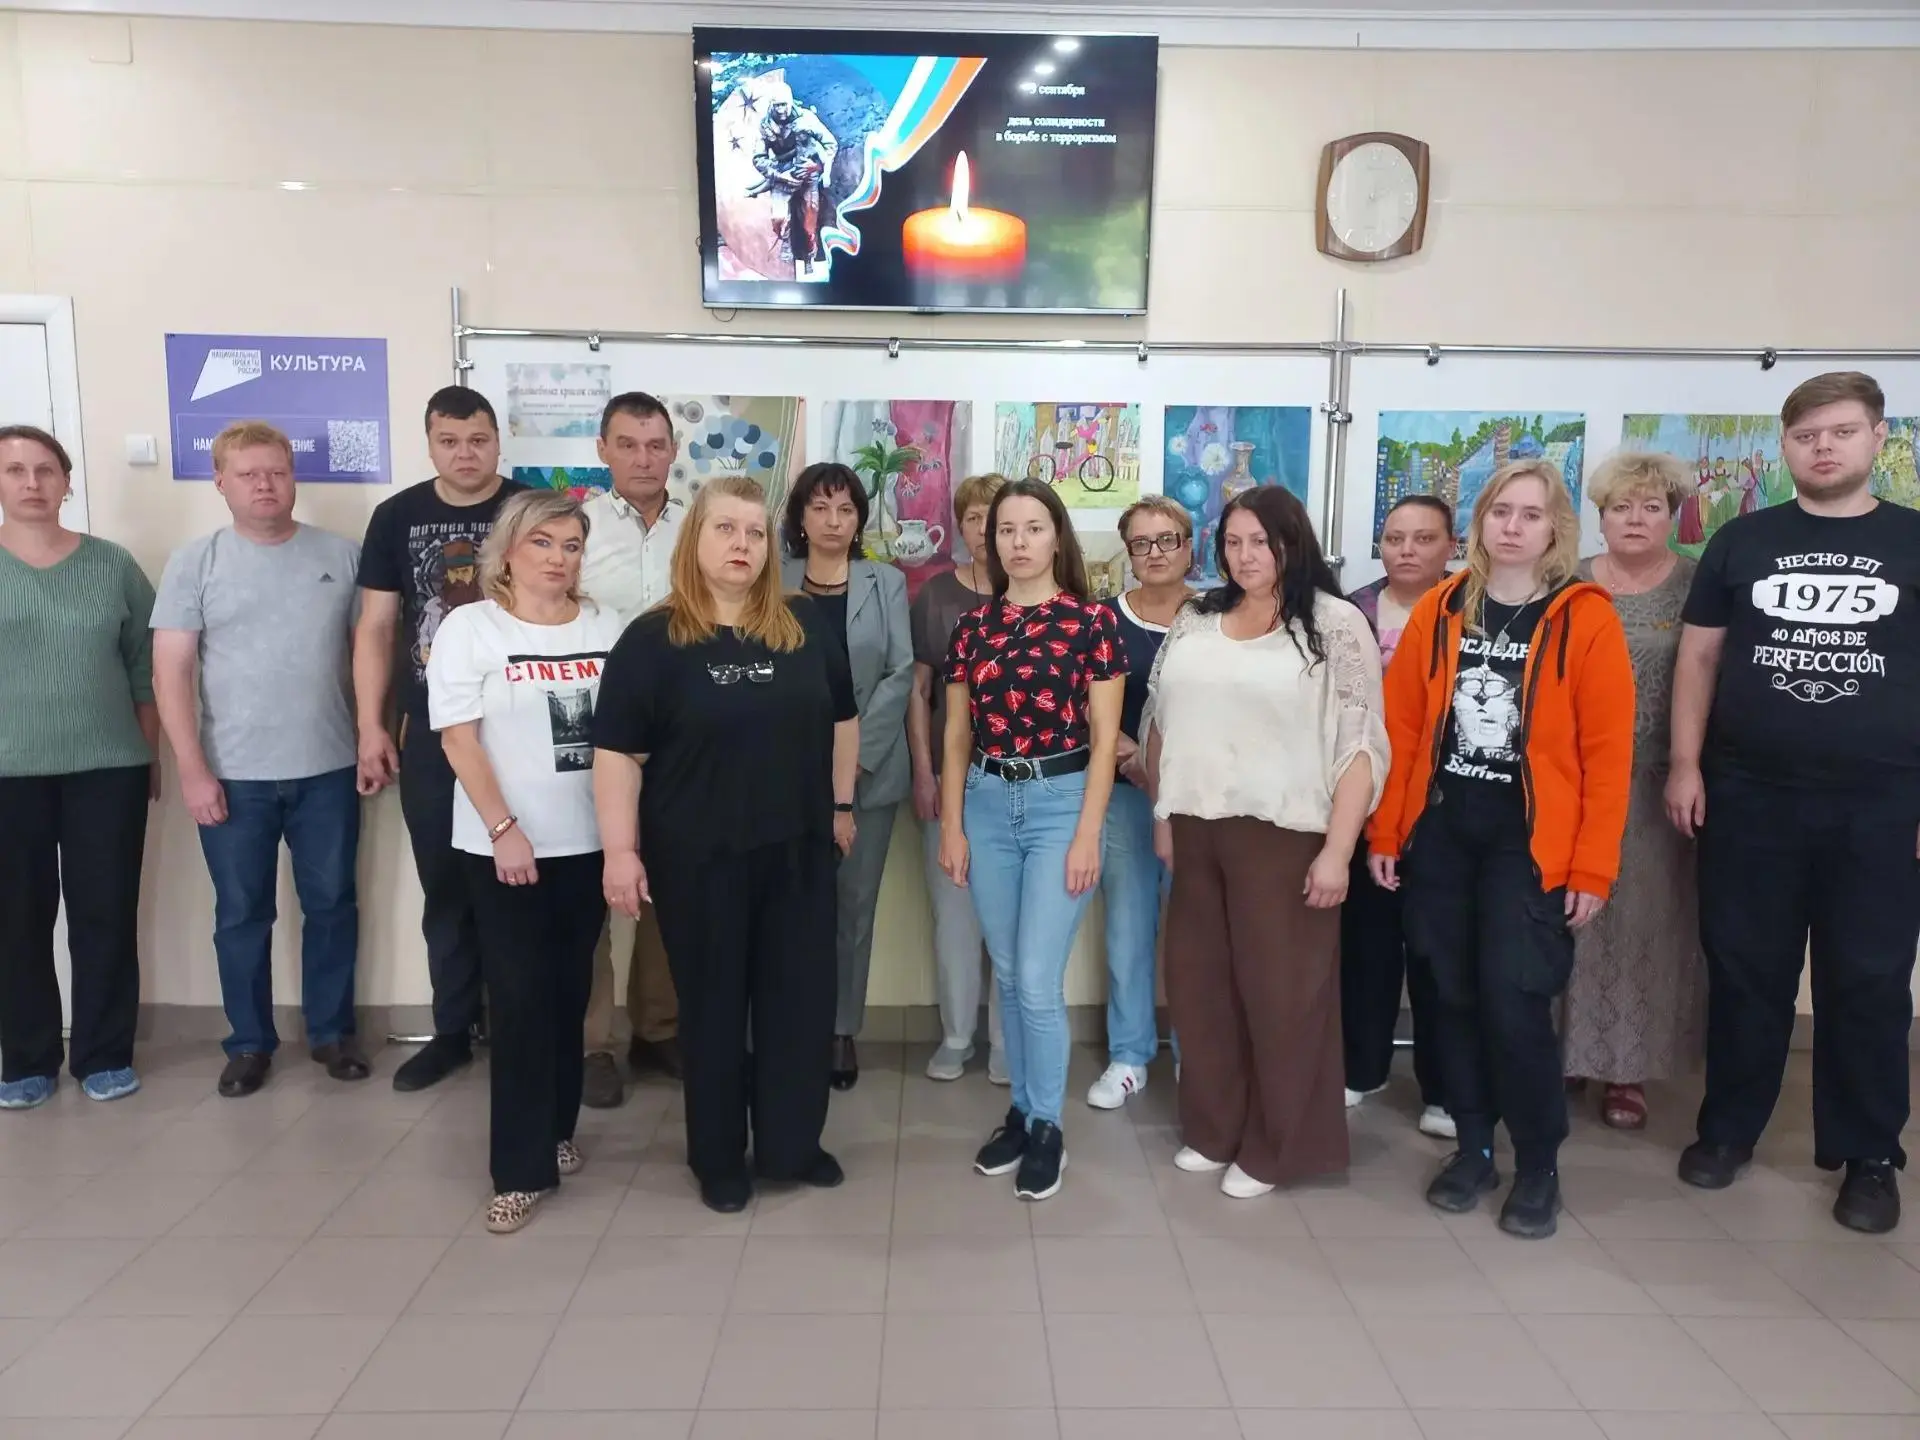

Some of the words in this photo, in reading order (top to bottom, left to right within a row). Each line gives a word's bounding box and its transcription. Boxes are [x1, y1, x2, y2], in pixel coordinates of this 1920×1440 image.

[1007, 117, 1032, 127] день
[995, 132, 1003, 141] в
[1003, 130, 1041, 144] борьбе
[1041, 133, 1049, 142] с
[1049, 133, 1117, 145] терроризмом
[270, 354, 366, 373] КУЛЬТУРА
[1774, 552, 1848, 570] HECHO
[1849, 556, 1883, 574] EN
[1772, 582, 1877, 614] 1975
[1771, 628, 1789, 642] 40
[1843, 631, 1867, 647] DE
[1753, 646, 1886, 679] PERFECCIÓN
